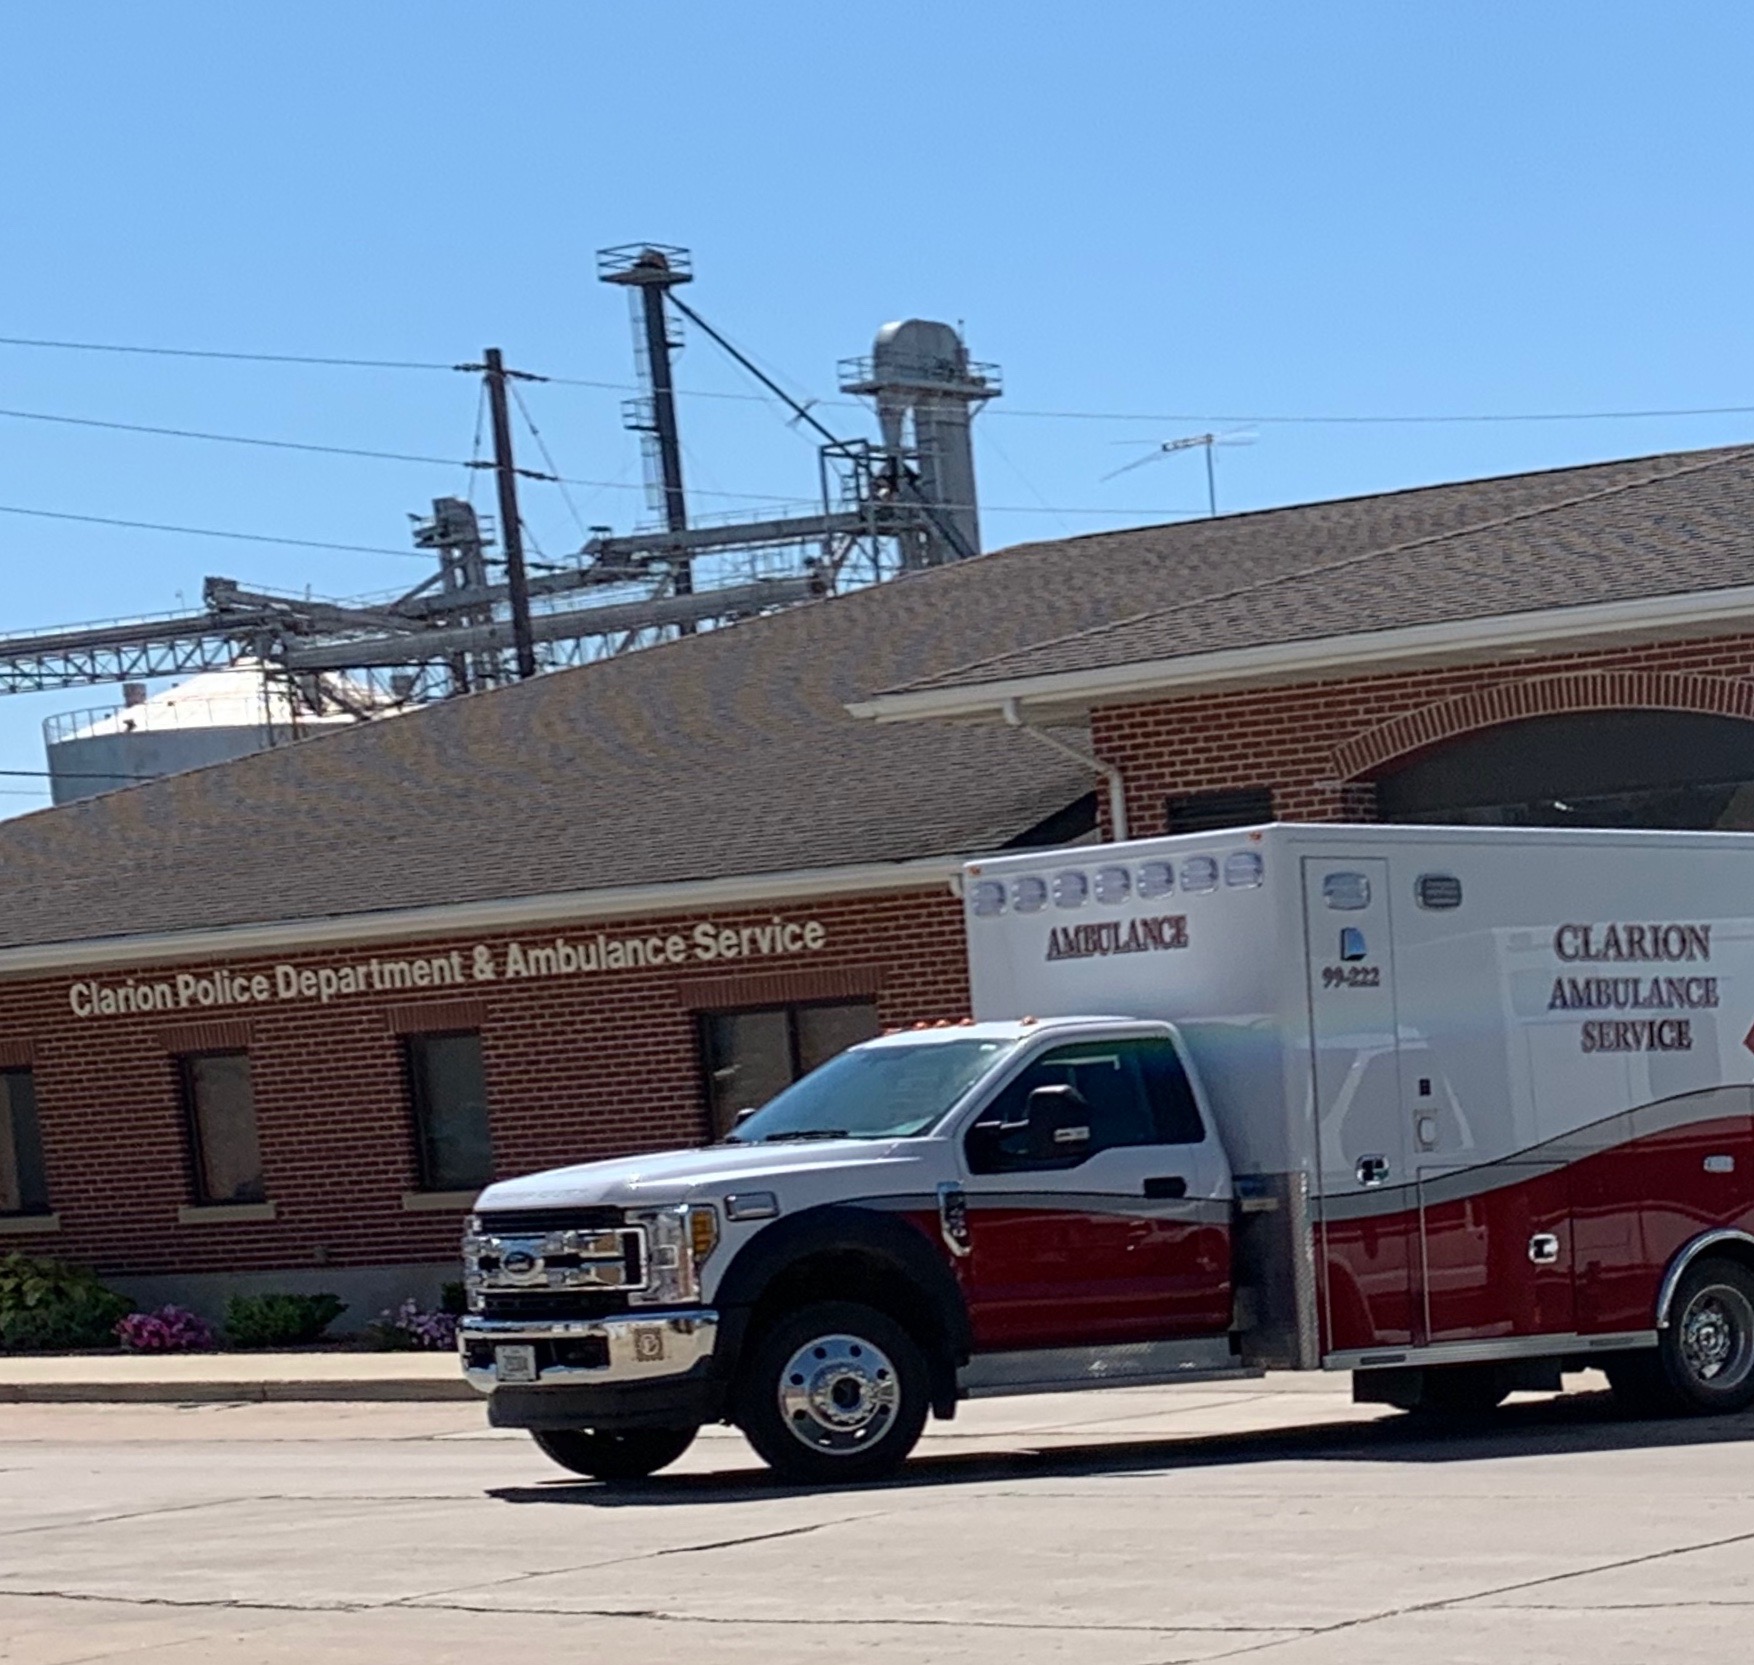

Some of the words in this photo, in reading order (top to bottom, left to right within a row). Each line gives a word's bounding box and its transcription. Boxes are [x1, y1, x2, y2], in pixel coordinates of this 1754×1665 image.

[1046, 914, 1189, 961] AMBULANCE
[1554, 923, 1711, 962] CLARION
[69, 978, 173, 1017] Clarion
[176, 970, 269, 1008] Police
[275, 950, 464, 1003] Department
[472, 945, 497, 981] &
[505, 935, 686, 979] Ambulance
[693, 916, 826, 961] Service
[1322, 966, 1379, 988] 99-222
[1548, 976, 1719, 1010] AMBULANCE
[1581, 1019, 1693, 1053] SERVICE
